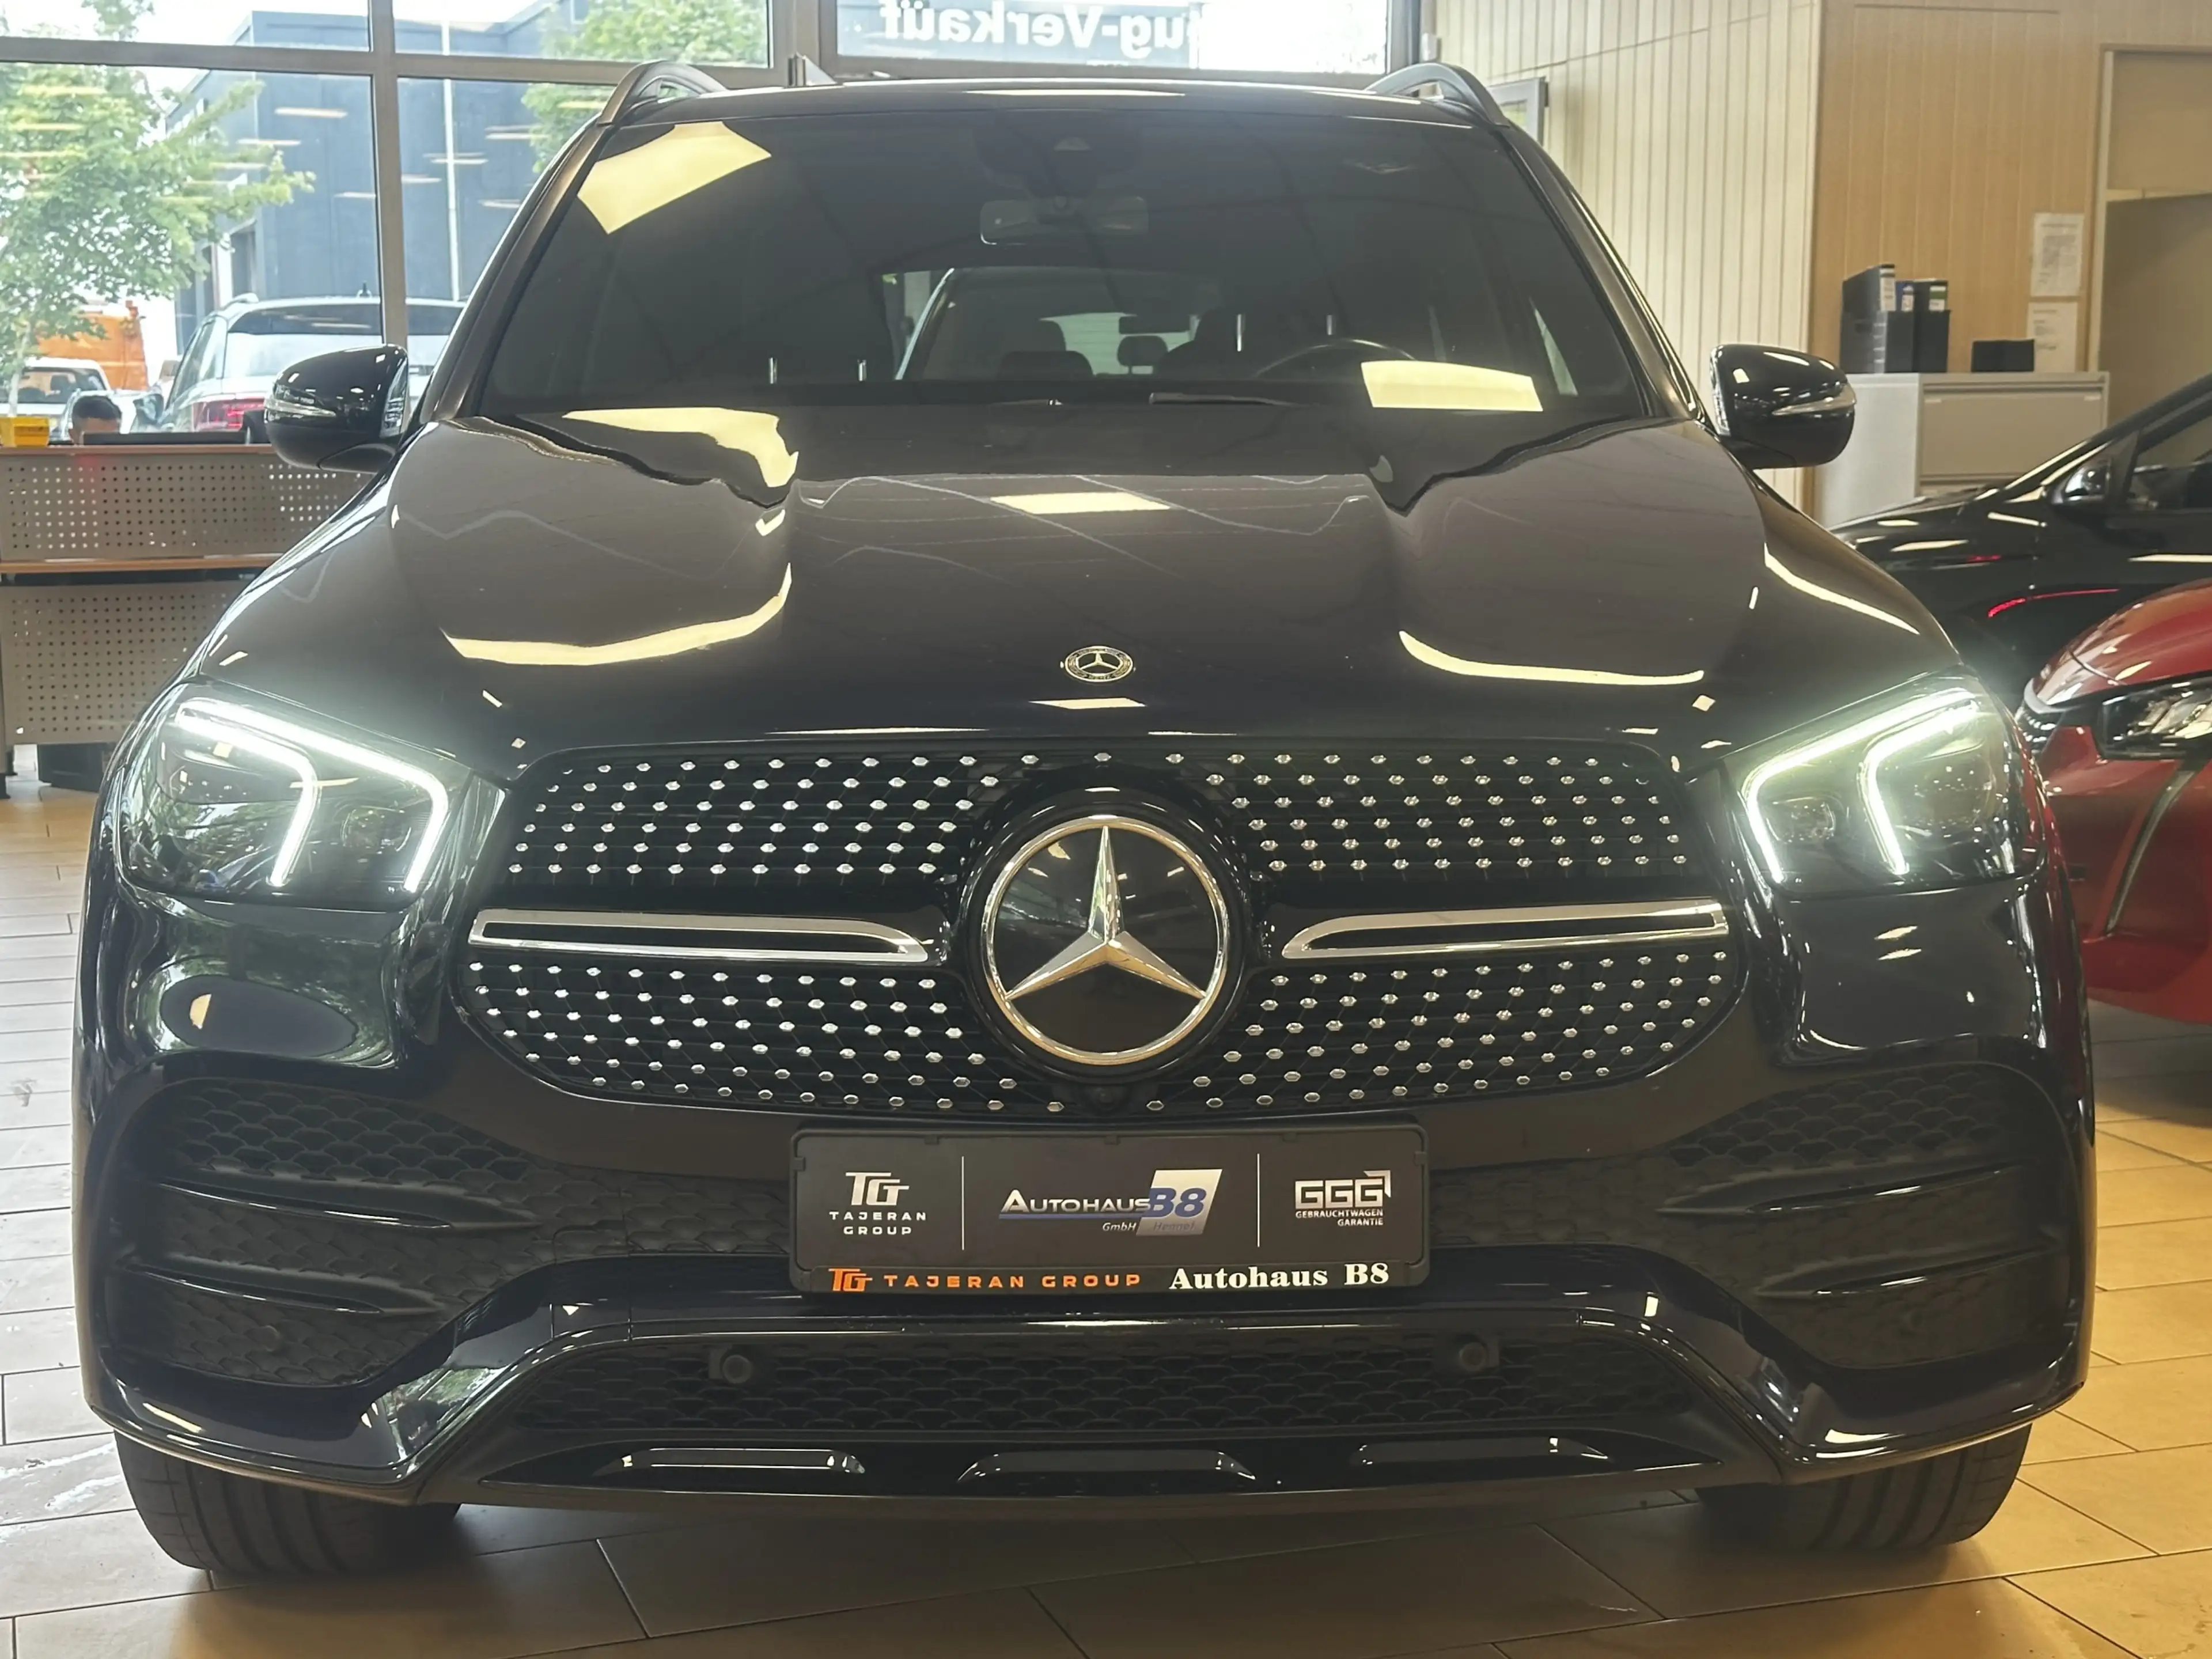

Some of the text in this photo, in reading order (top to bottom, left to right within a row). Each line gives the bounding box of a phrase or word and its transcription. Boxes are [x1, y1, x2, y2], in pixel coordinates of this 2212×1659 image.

[845, 1172, 910, 1206] TG
[1295, 1178, 1383, 1209] GGG
[1143, 1187, 1207, 1218] B8
[829, 1211, 927, 1221] TAJERAN
[1296, 1209, 1383, 1219] GEBRAUCHTWAGEN
[1103, 1222, 1137, 1232] GmbH
[1337, 1218, 1384, 1227] GARANTIE
[843, 1226, 912, 1235] GROUP
[884, 1275, 1024, 1288] TAJERAN
[1041, 1274, 1141, 1288] GROUP
[1169, 1263, 1389, 1290] Autohaus B8
